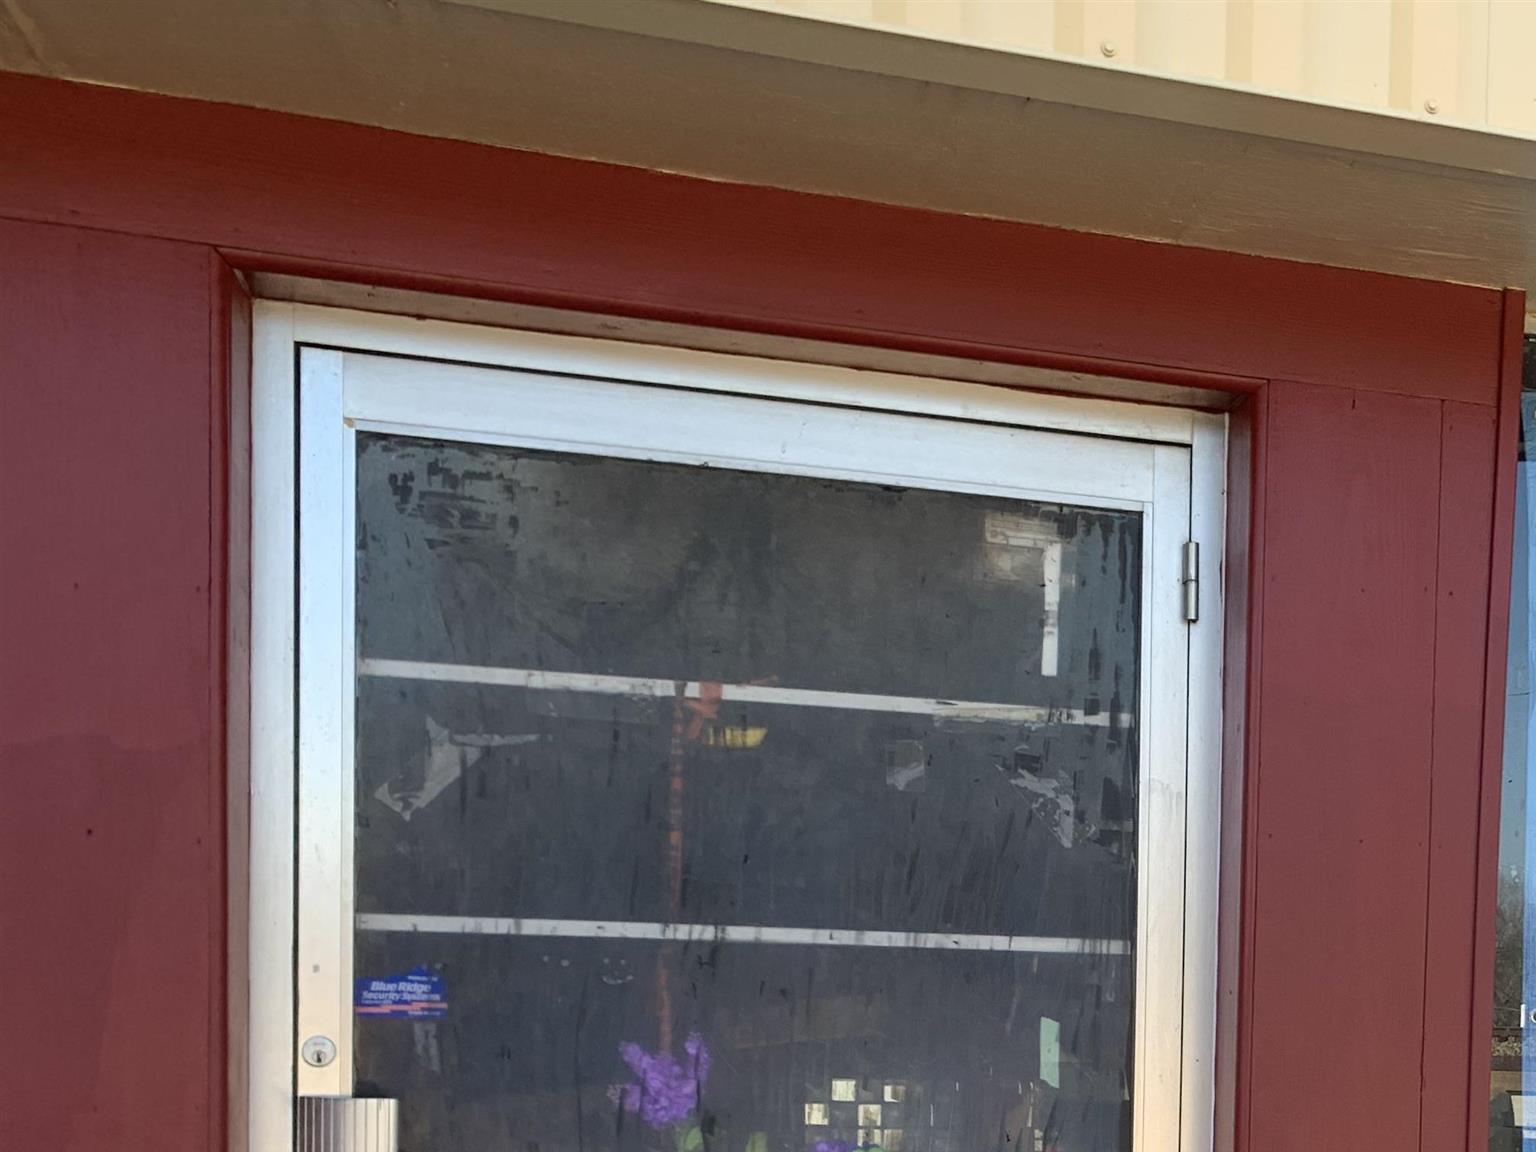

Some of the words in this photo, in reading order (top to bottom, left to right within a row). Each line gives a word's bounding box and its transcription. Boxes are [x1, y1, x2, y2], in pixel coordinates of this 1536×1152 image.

[370, 981, 397, 992] Blue
[398, 981, 432, 994] Ridge
[362, 991, 400, 1002] Security
